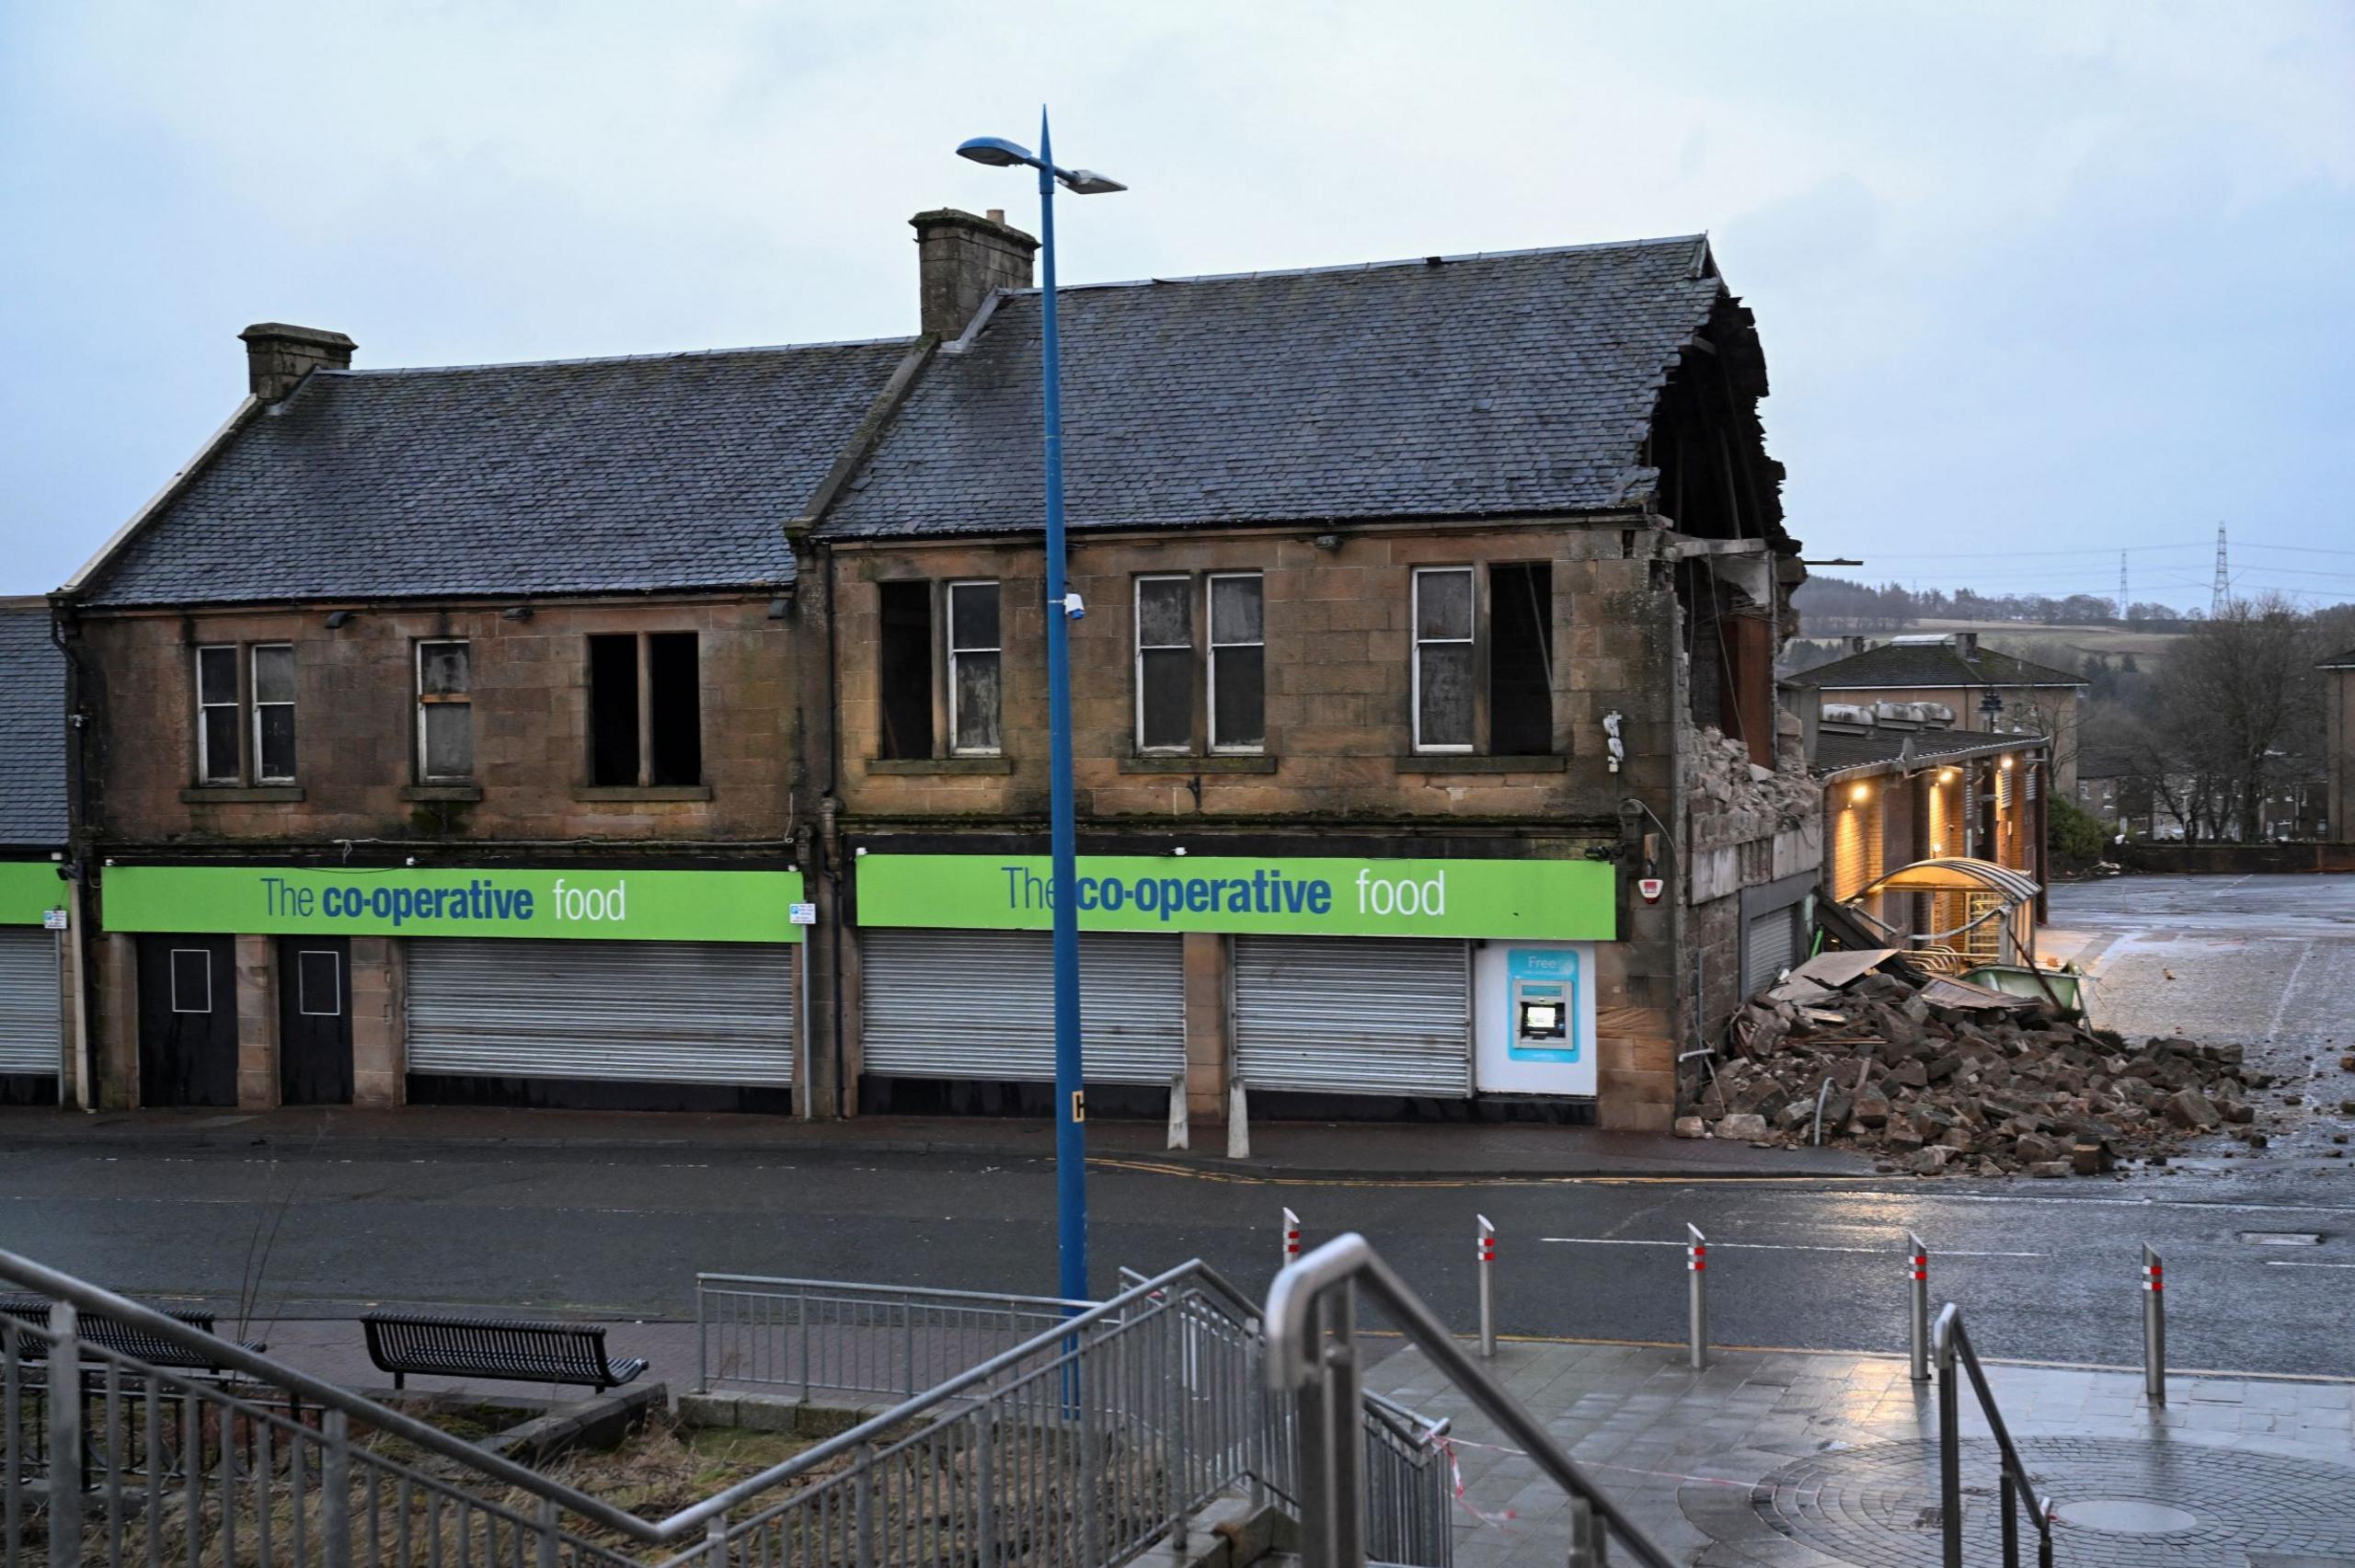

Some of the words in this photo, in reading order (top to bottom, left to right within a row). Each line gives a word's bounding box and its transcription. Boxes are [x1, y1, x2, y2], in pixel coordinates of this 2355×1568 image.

[259, 877, 314, 917] The
[322, 879, 534, 926] co-operative
[552, 878, 626, 921] food
[1075, 869, 1332, 921] co-operative
[1355, 868, 1445, 916] food
[1528, 956, 1557, 969] Free
